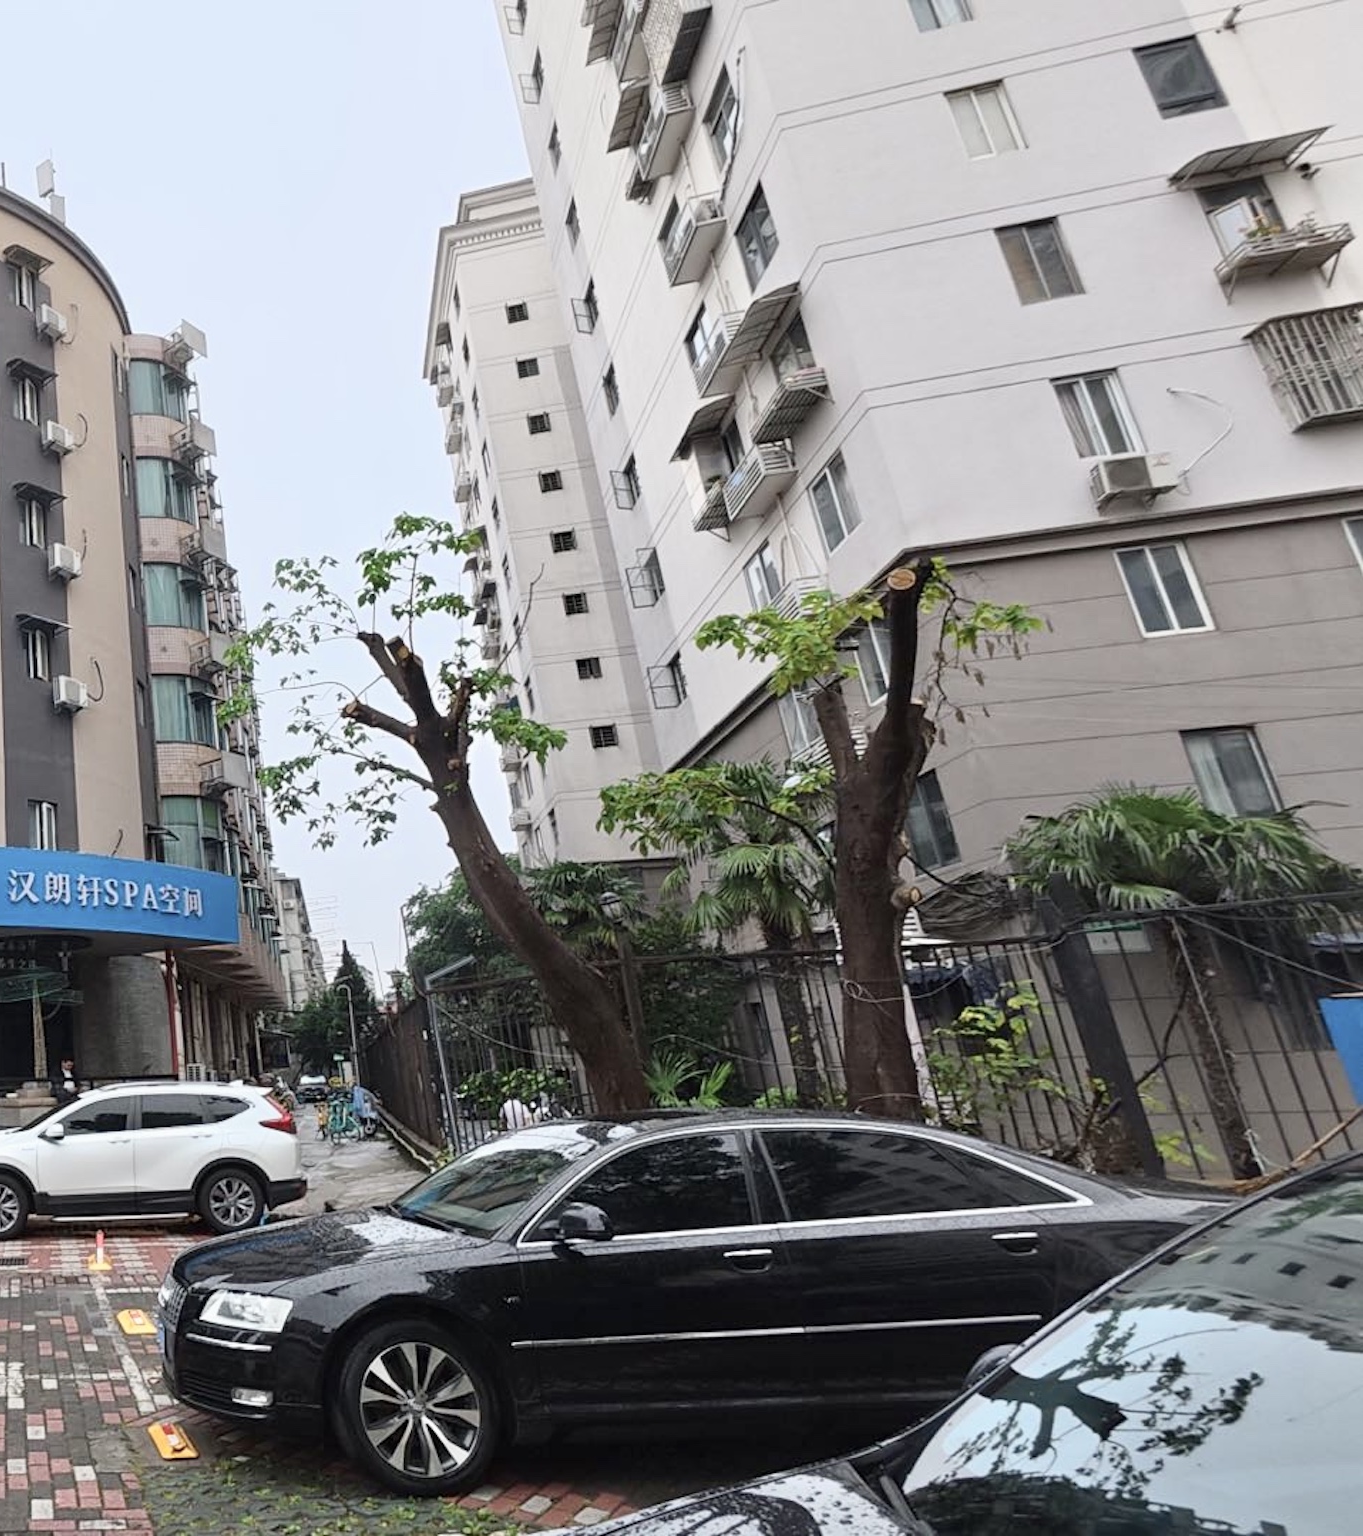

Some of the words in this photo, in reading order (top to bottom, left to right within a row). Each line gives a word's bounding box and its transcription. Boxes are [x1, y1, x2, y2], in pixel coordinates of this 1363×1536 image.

[8, 868, 204, 918] 汉朗轩SPA空间
